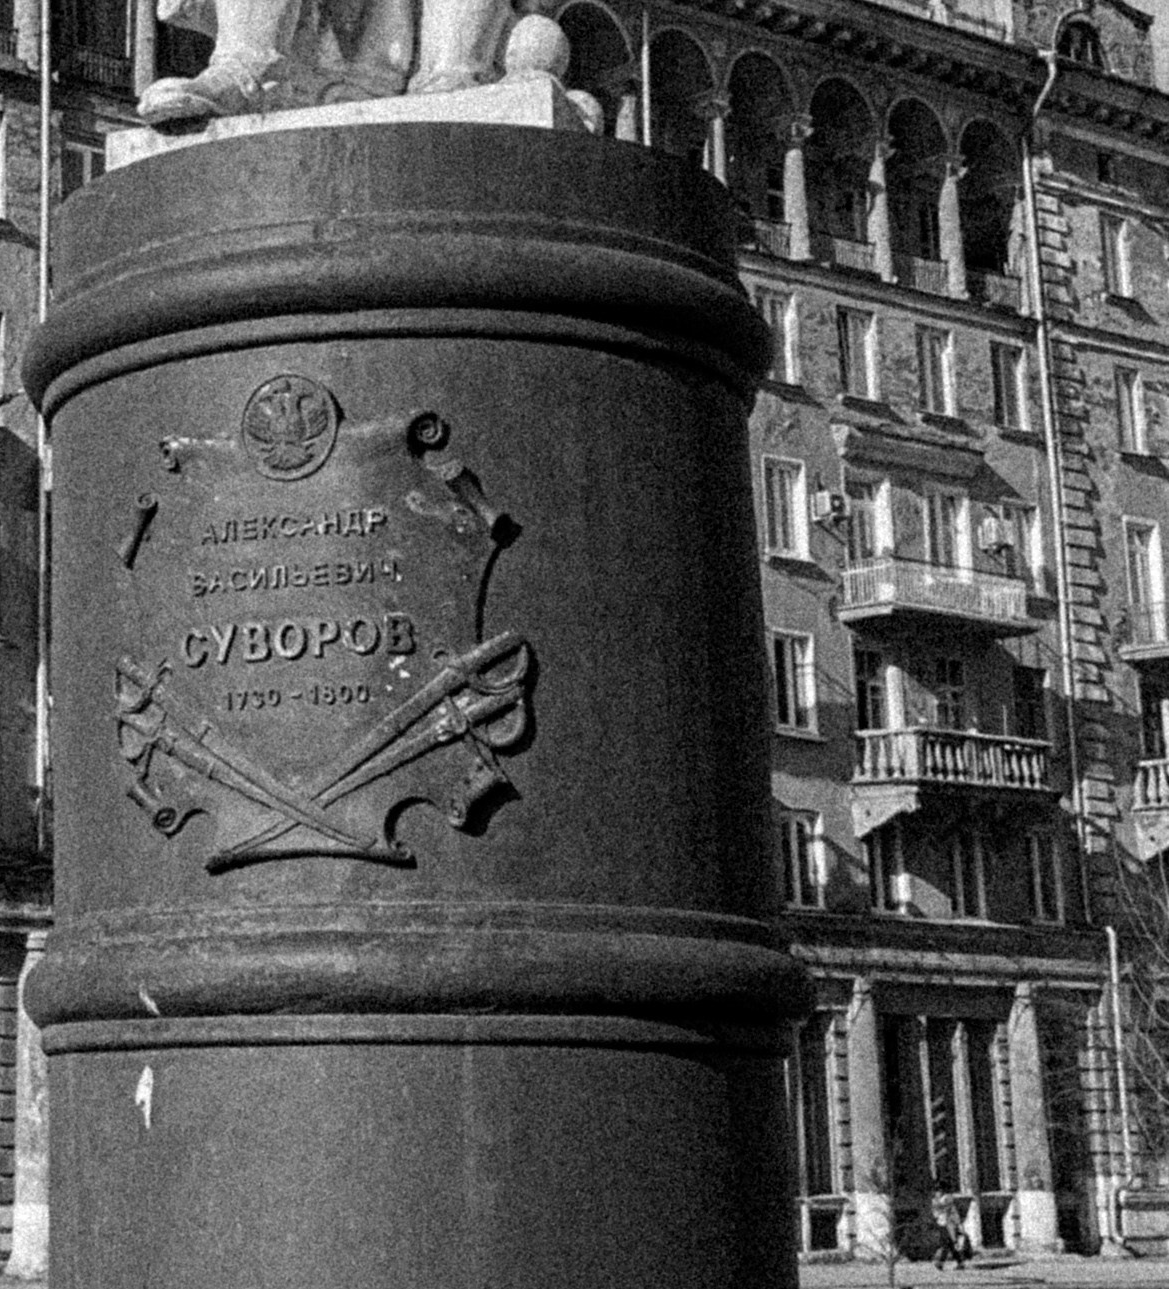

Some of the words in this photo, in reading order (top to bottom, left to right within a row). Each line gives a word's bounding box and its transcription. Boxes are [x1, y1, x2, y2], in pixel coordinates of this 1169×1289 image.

[200, 509, 388, 546] АЛЕКСАНДР
[191, 561, 399, 597] ВАСИЛЬЕВИЧ
[184, 613, 416, 669] СУВОРОВ
